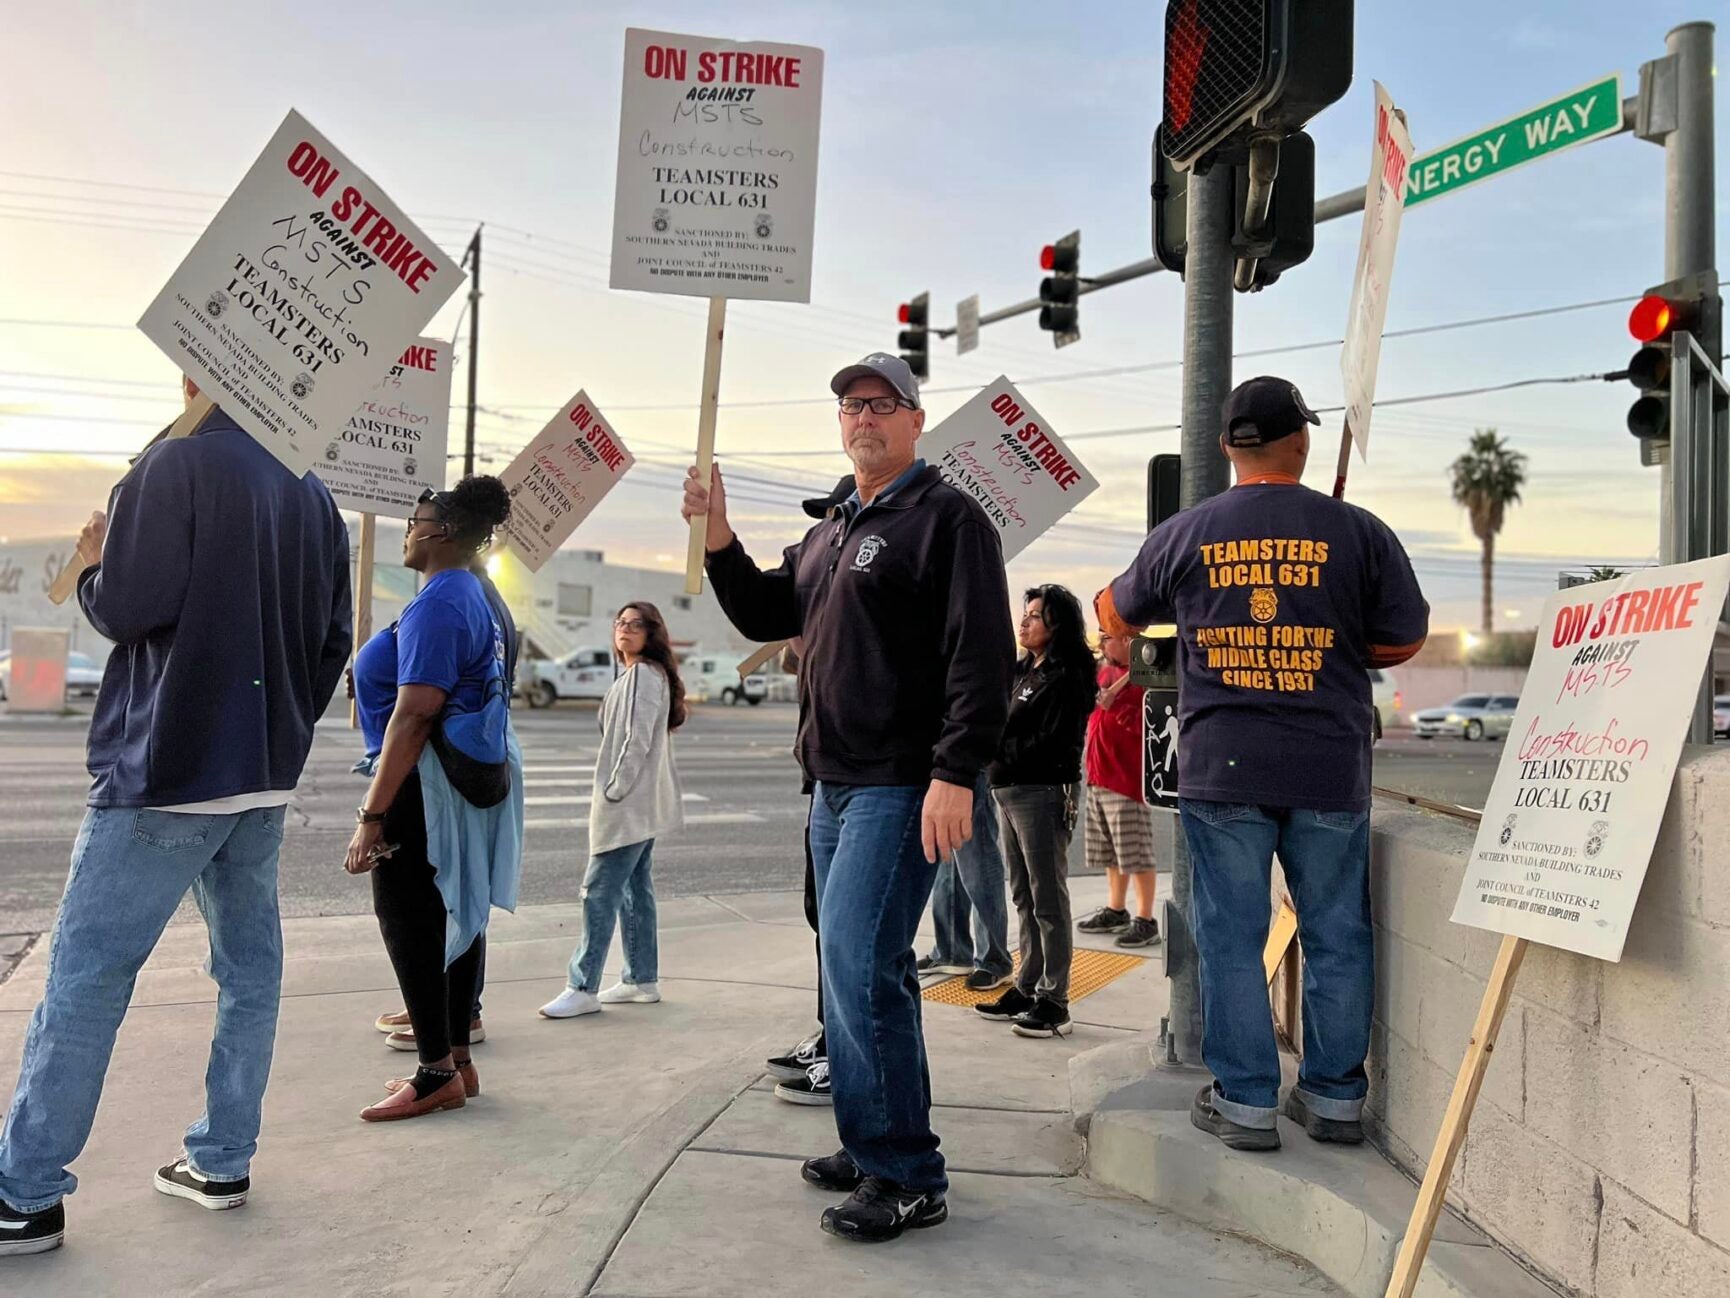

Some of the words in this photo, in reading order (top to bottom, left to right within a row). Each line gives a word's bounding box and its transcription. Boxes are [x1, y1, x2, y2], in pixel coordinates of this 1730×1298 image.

[644, 45, 687, 81] ON
[697, 51, 801, 88] STRIKE
[686, 87, 755, 102] AGAINST
[673, 101, 763, 126] MSTS
[1403, 133, 1506, 199] NERGY
[1524, 96, 1597, 150] WAY
[652, 167, 779, 190] TEAMSTERS
[660, 188, 732, 207] LOCAL
[738, 192, 768, 209] 631
[287, 142, 340, 198] ON
[331, 186, 438, 294] STRIKE
[309, 211, 377, 270] AGAINST
[626, 235, 675, 246] SOUTHERN
[677, 239, 713, 249] NEVADA
[715, 241, 759, 251] BUILDING
[762, 244, 797, 254] TRADES
[675, 229, 729, 239] SANCTIONED
[272, 215, 371, 304] MSTS
[637, 257, 662, 265] JOINT
[666, 259, 706, 269] COUNCIL
[719, 261, 773, 273] TEAMSTERS
[702, 250, 720, 258] AND
[233, 253, 345, 365] TEAMSTERS
[261, 244, 368, 356] Construction
[226, 278, 289, 346] LOCAL
[293, 344, 323, 373] 631
[175, 293, 217, 336] SOUTHERN
[217, 332, 248, 366] NEVADA
[248, 363, 287, 402] BUILDING
[287, 398, 319, 431] TRADES
[221, 323, 271, 373] SANCTIONED
[398, 345, 438, 372] IKE
[173, 320, 198, 344] JOINT
[197, 342, 231, 377] COUNCIL
[231, 375, 241, 385] of
[240, 383, 287, 429] TEAMSTERS
[286, 425, 297, 437] 42
[231, 362, 249, 380] AND
[222, 380, 234, 393] ANY
[233, 390, 252, 410] OTHER
[250, 407, 279, 434] EMPLOYER
[336, 430, 388, 450] OCAL
[391, 441, 414, 455] 631
[347, 416, 422, 442] AMSTERS
[569, 403, 594, 431] ON
[586, 423, 625, 473] STRIKE
[990, 393, 1026, 427] ON
[1016, 421, 1082, 492] STRIKE
[574, 437, 601, 465] AGAINST
[992, 443, 1033, 486] MSTS
[1000, 432, 1042, 473] AGAINST
[522, 474, 549, 508] LOCAL
[529, 462, 574, 514] TEAMSTERS
[941, 450, 1011, 528] TEAMSTERS
[952, 440, 1026, 528] Construction
[1200, 539, 1329, 565] TEAMSTERS
[1209, 564, 1274, 589] LOCAL
[1279, 563, 1320, 587] 631
[1552, 603, 1594, 649] ON
[1589, 581, 1704, 640] STRIKE
[1272, 626, 1304, 648] FOR
[1302, 627, 1335, 648] THE
[1208, 647, 1267, 669] MIDDLE
[1269, 649, 1323, 672] CLASS
[1571, 639, 1640, 667] AGAINST
[1222, 670, 1274, 691] SINCE
[1556, 661, 1632, 704] MSTS
[1519, 758, 1632, 783] TEAMSTERS
[1514, 786, 1573, 810] LOCAL
[1578, 789, 1612, 813] 631
[1512, 840, 1560, 855] SANCTIONED
[1561, 846, 1577, 858] BY:
[1478, 851, 1510, 865] SOUTHERN
[1511, 854, 1539, 868] NEVADA
[1538, 858, 1582, 874] BUILDING
[1584, 864, 1623, 881] TRADES
[1525, 871, 1542, 882] AND
[1476, 878, 1495, 890] JOINT
[1495, 881, 1525, 896] COUNCIL
[1533, 886, 1588, 908] TEAMSTERS
[1588, 898, 1600, 910] 42
[1529, 902, 1547, 915] OTHER
[1547, 906, 1580, 923] EMPLOYER
